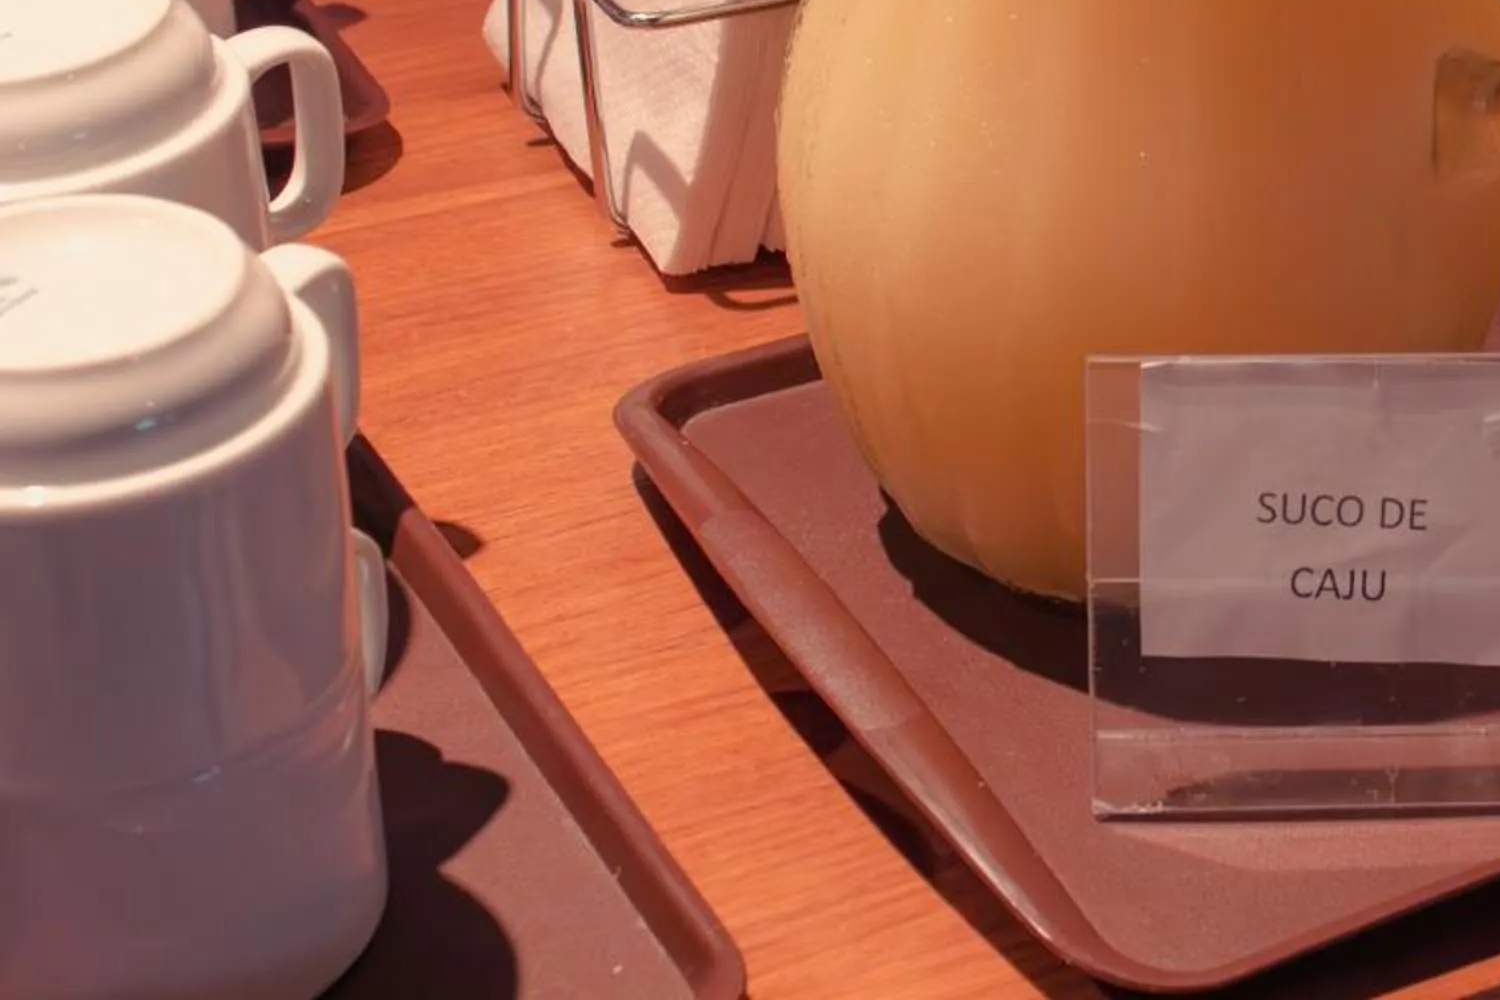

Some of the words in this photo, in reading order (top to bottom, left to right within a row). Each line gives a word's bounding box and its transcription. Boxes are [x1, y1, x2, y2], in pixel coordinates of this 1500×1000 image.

[1256, 492, 1364, 528] SUCO
[1379, 497, 1428, 531] DE
[1290, 566, 1387, 602] CAJU
